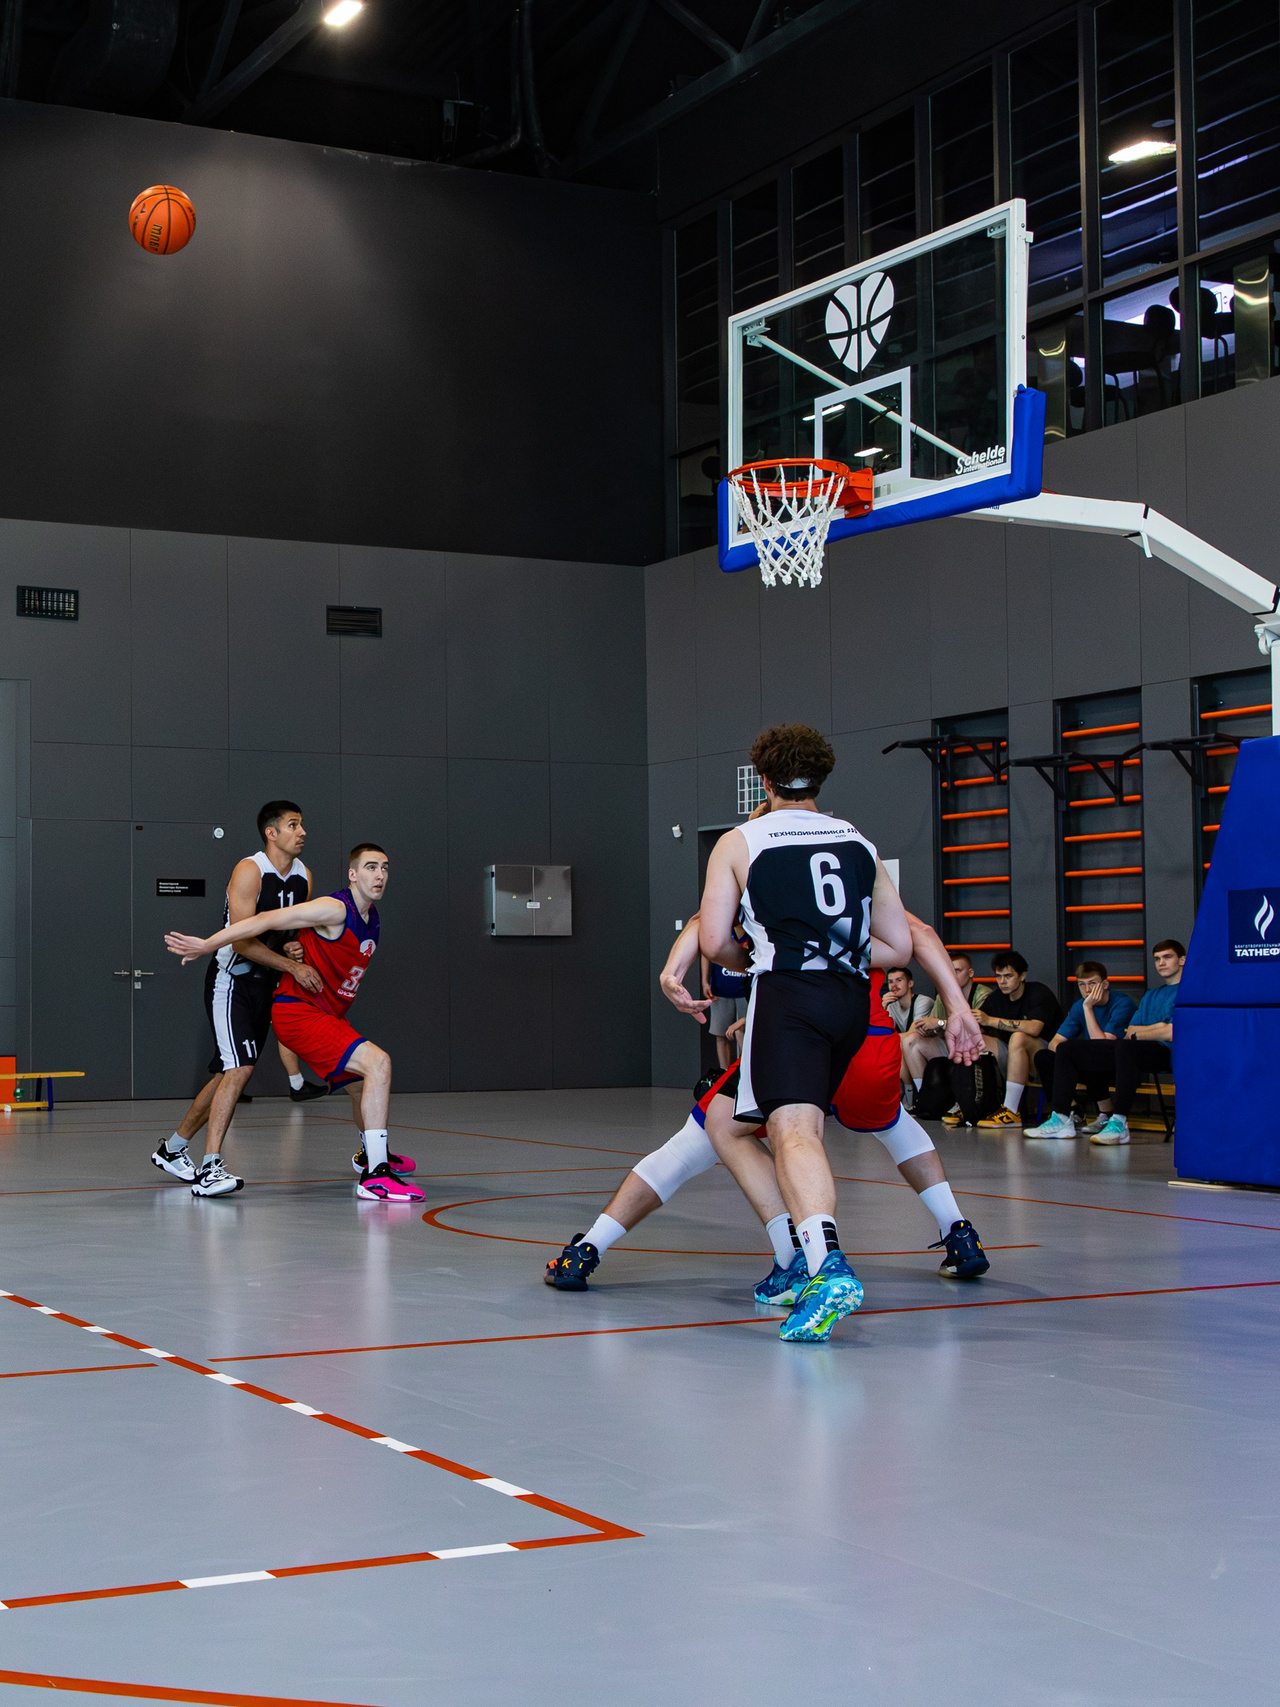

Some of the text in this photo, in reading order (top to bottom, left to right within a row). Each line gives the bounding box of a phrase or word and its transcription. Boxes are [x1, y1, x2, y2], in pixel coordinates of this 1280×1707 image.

[955, 444, 1006, 475] Schelde
[768, 829, 845, 838] ТЕХНОДИНАМИКА
[809, 852, 846, 916] 6
[277, 889, 294, 909] 11
[1234, 948, 1280, 956] ТАТНЕФ
[341, 966, 364, 992] 3
[242, 1039, 258, 1059] 11
